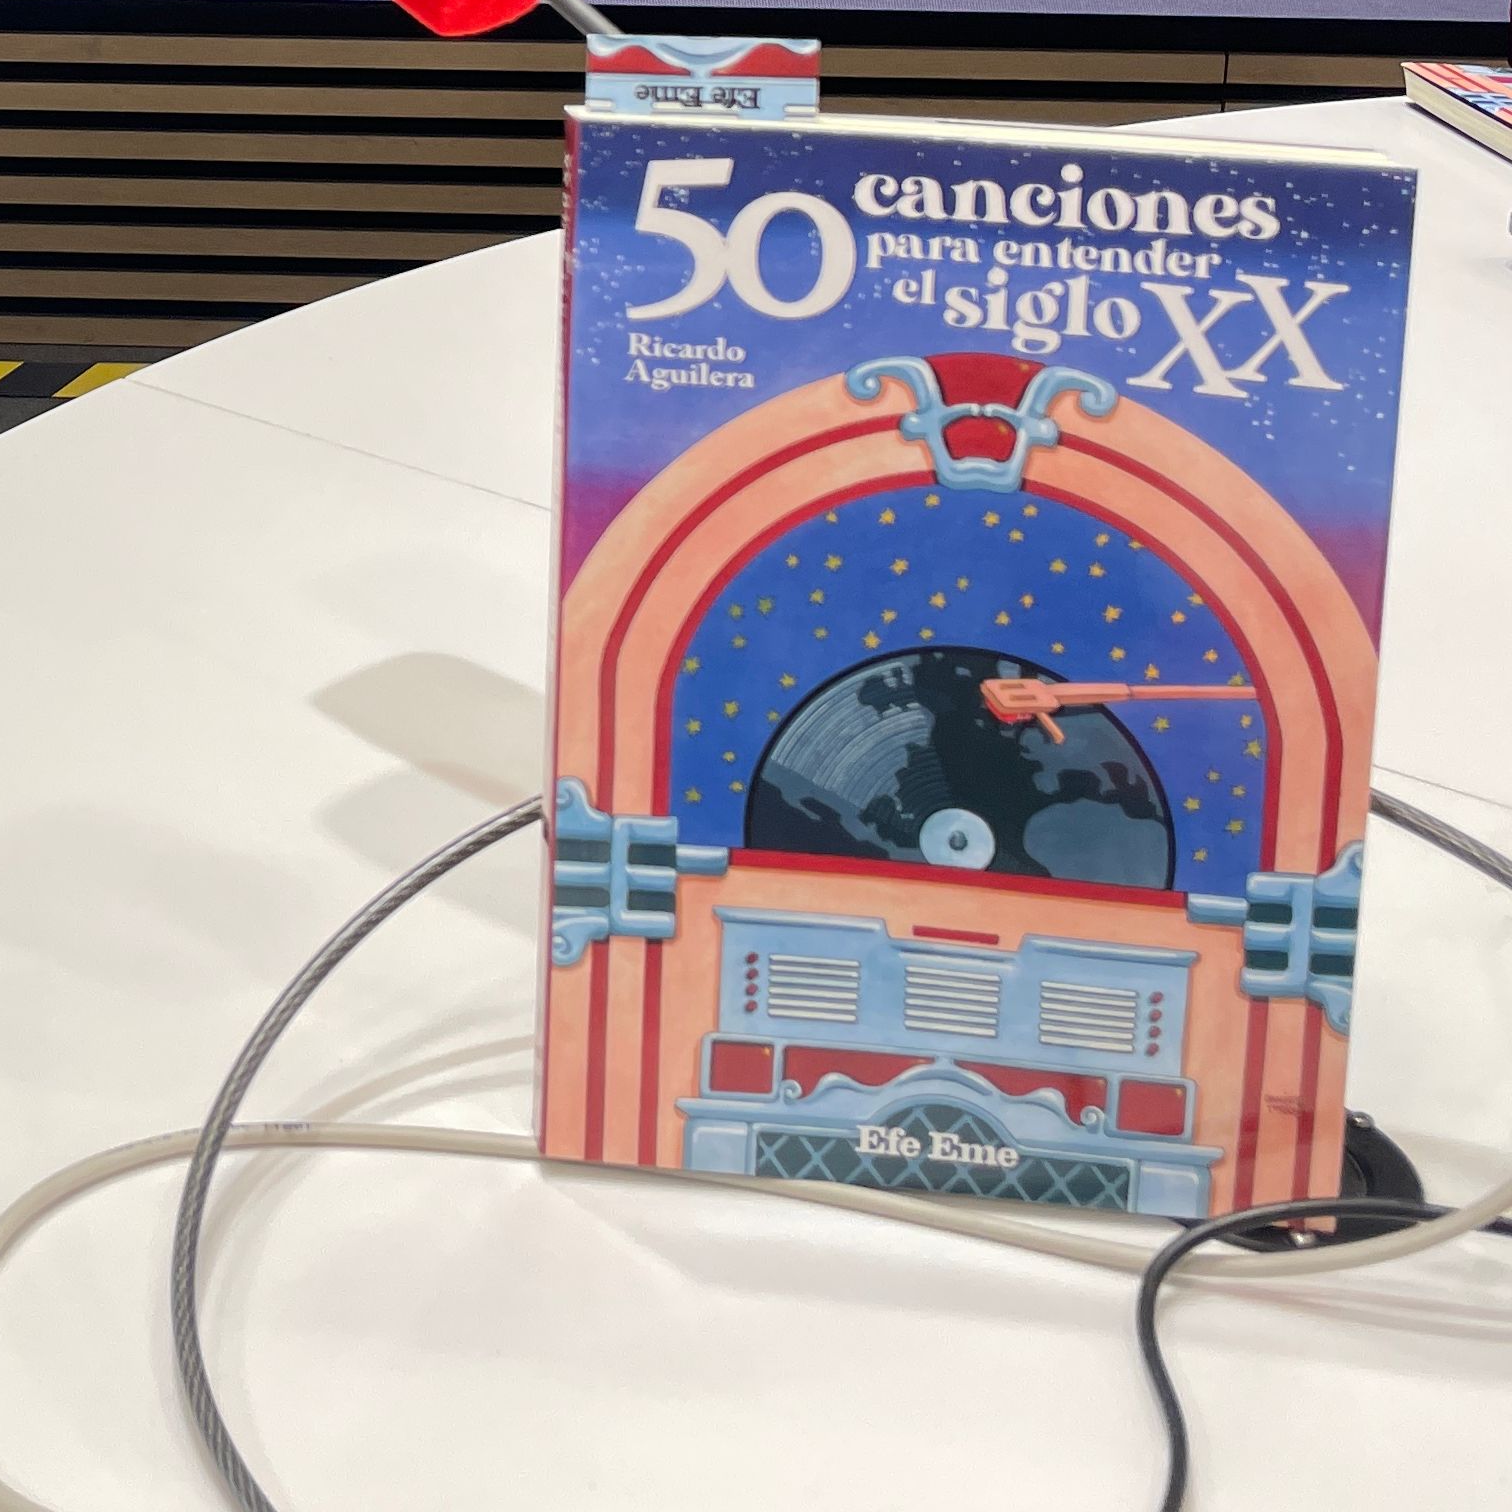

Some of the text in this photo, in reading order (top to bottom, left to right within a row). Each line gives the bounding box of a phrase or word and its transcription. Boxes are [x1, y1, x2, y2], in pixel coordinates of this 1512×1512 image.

[633, 85, 761, 109] Efe Eme
[626, 157, 857, 320] 50
[853, 164, 1281, 240] canciones
[865, 230, 1222, 278] para entender
[627, 332, 747, 362] Ricardo
[892, 268, 1351, 399] el siglo XX
[624, 358, 755, 391] Aguilera
[854, 1124, 1021, 1168] Efe Eme
